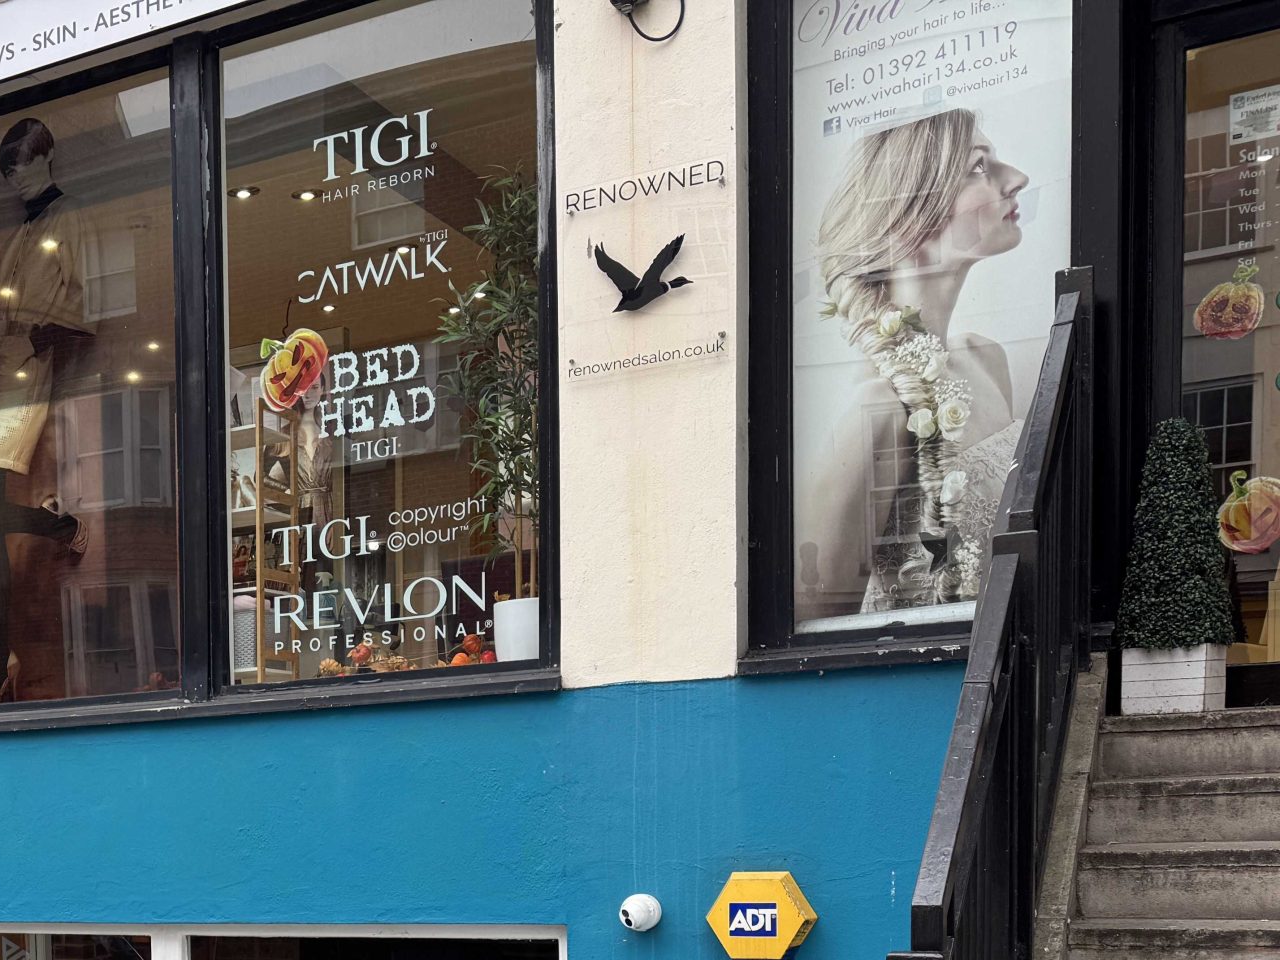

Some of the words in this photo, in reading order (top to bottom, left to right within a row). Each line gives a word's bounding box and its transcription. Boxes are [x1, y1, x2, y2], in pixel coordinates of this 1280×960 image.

[32, 21, 76, 51] SKIN
[833, 36, 886, 61] Bringing
[890, 26, 919, 47] your
[923, 14, 949, 32] hair
[953, 10, 966, 20] to
[826, 73, 855, 96] Tel:
[862, 49, 927, 85] 01392
[934, 20, 1018, 60] 411119
[827, 45, 1018, 114] www.vivahair134.co.uk
[946, 64, 1028, 97] @vivahair134
[845, 114, 871, 128] Viva
[873, 106, 897, 121] Hair
[322, 184, 360, 203] HAIR
[368, 165, 435, 192] REBORN
[566, 160, 724, 214] RENOWNED
[1239, 168, 1267, 181] Mon
[1238, 202, 1266, 215] Wed
[1239, 188, 1260, 198] Tue
[425, 229, 448, 242] TIGI
[1238, 220, 1272, 232] Thurs
[1238, 238, 1253, 249] Fri
[297, 241, 449, 304] CATWALK
[1238, 257, 1257, 267] Sat
[328, 343, 420, 395] BED
[568, 339, 725, 378] renownedsalon.co.uk
[317, 386, 436, 439] HEAD
[351, 437, 398, 462] TIGI
[388, 495, 487, 527] copyright
[274, 571, 486, 633] REVLON
[729, 908, 777, 931] ADT
